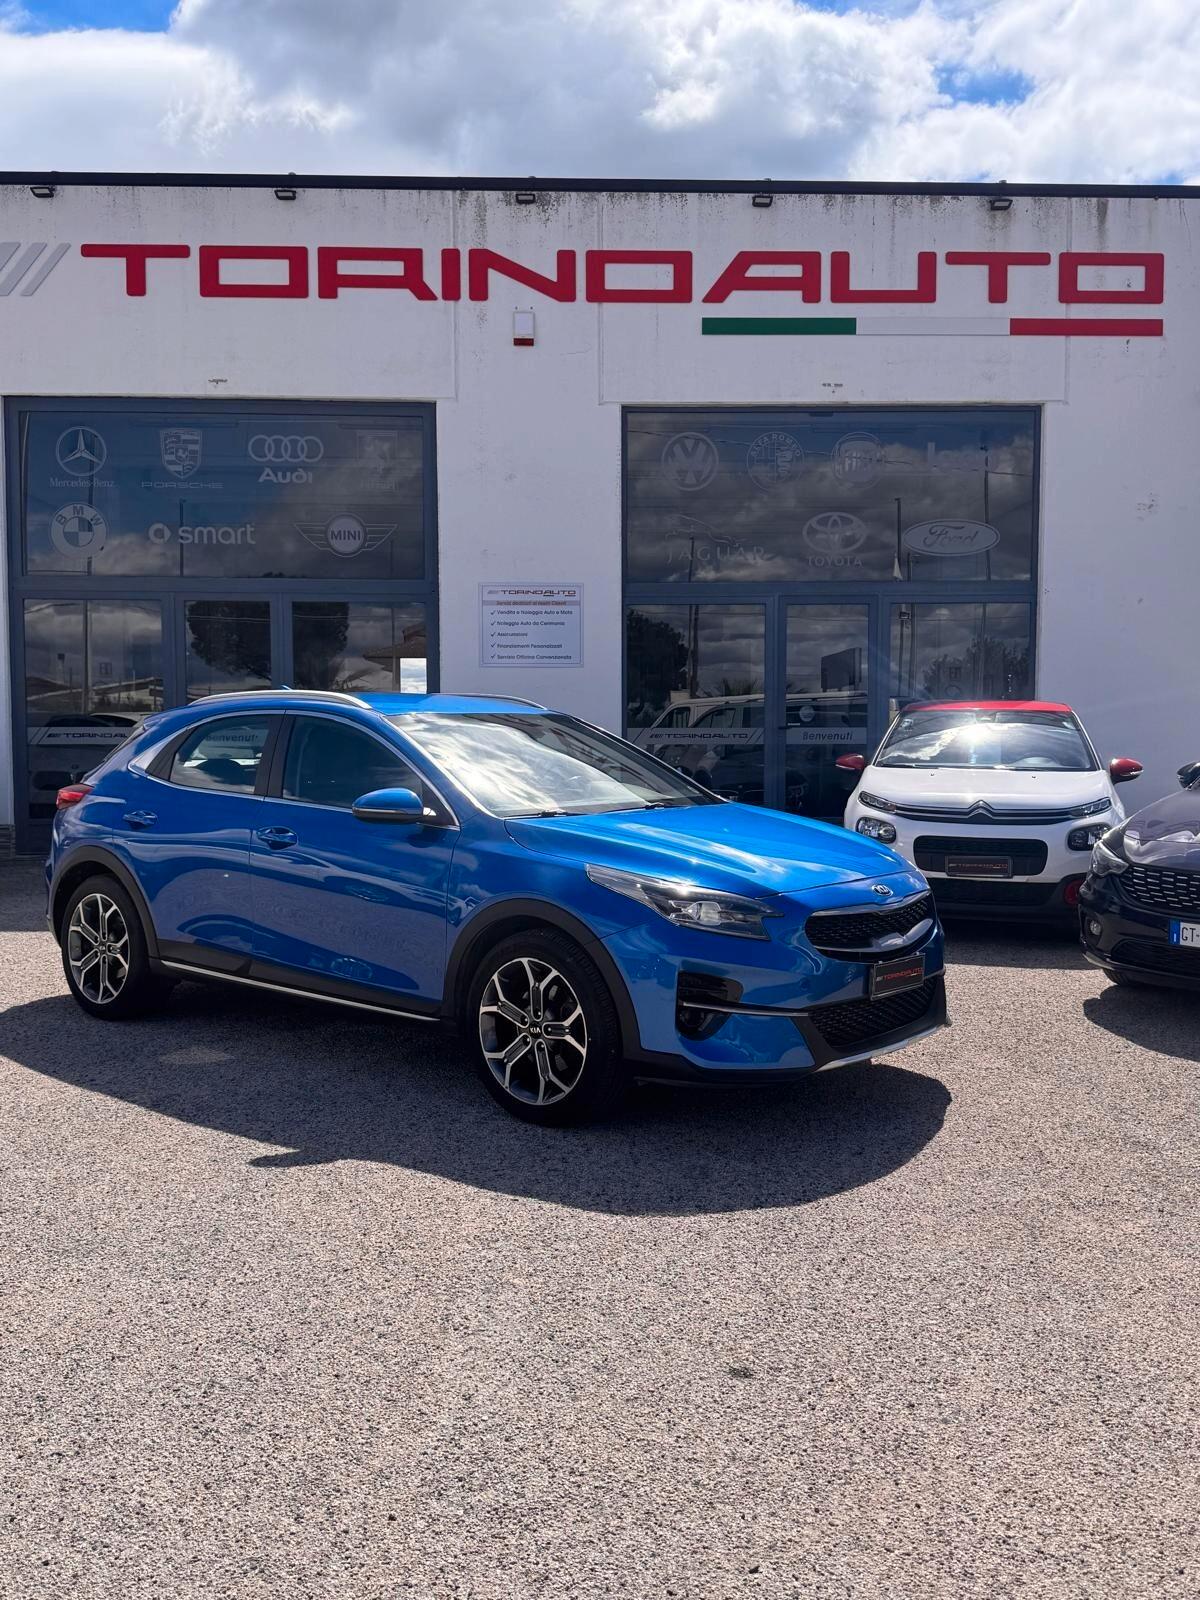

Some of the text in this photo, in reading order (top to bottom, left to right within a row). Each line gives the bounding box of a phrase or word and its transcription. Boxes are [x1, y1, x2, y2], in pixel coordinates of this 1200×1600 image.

[80, 243, 1164, 304] TORINOAUTO
[257, 467, 313, 484] Audi
[141, 481, 224, 489] PORSCHE
[178, 523, 256, 545] smart
[330, 530, 361, 542] MINI
[808, 555, 864, 568] TOYOTA
[802, 731, 853, 741] Benvenuti
